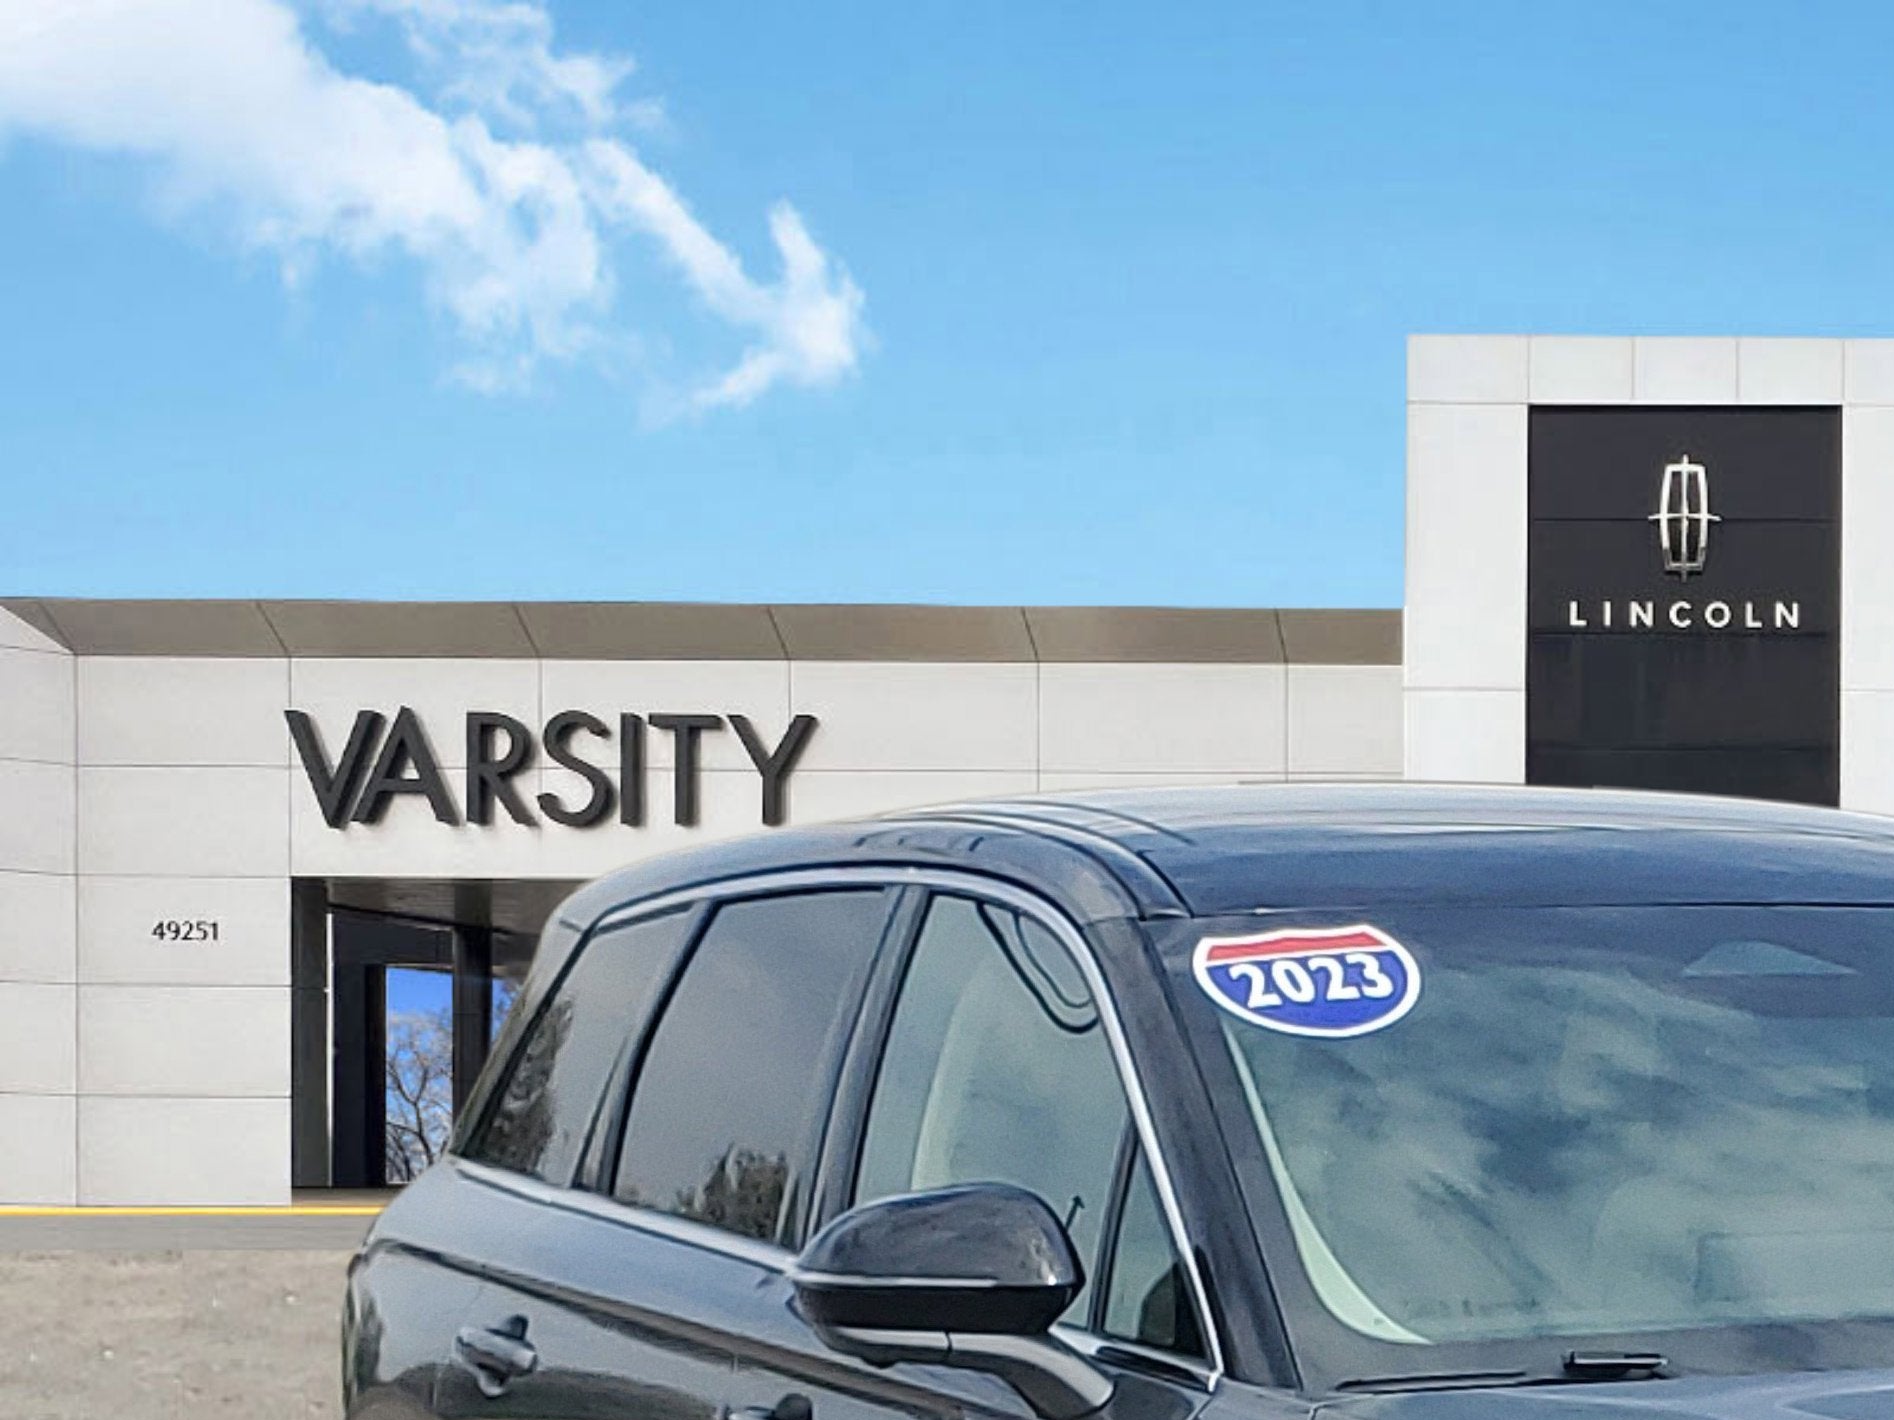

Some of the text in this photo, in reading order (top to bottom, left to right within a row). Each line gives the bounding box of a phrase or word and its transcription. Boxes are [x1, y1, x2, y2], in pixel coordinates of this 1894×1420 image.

[1568, 600, 1800, 628] LINCOLN
[283, 705, 820, 830] VARSITY
[151, 920, 219, 941] 49251
[1228, 952, 1394, 1009] 2023
